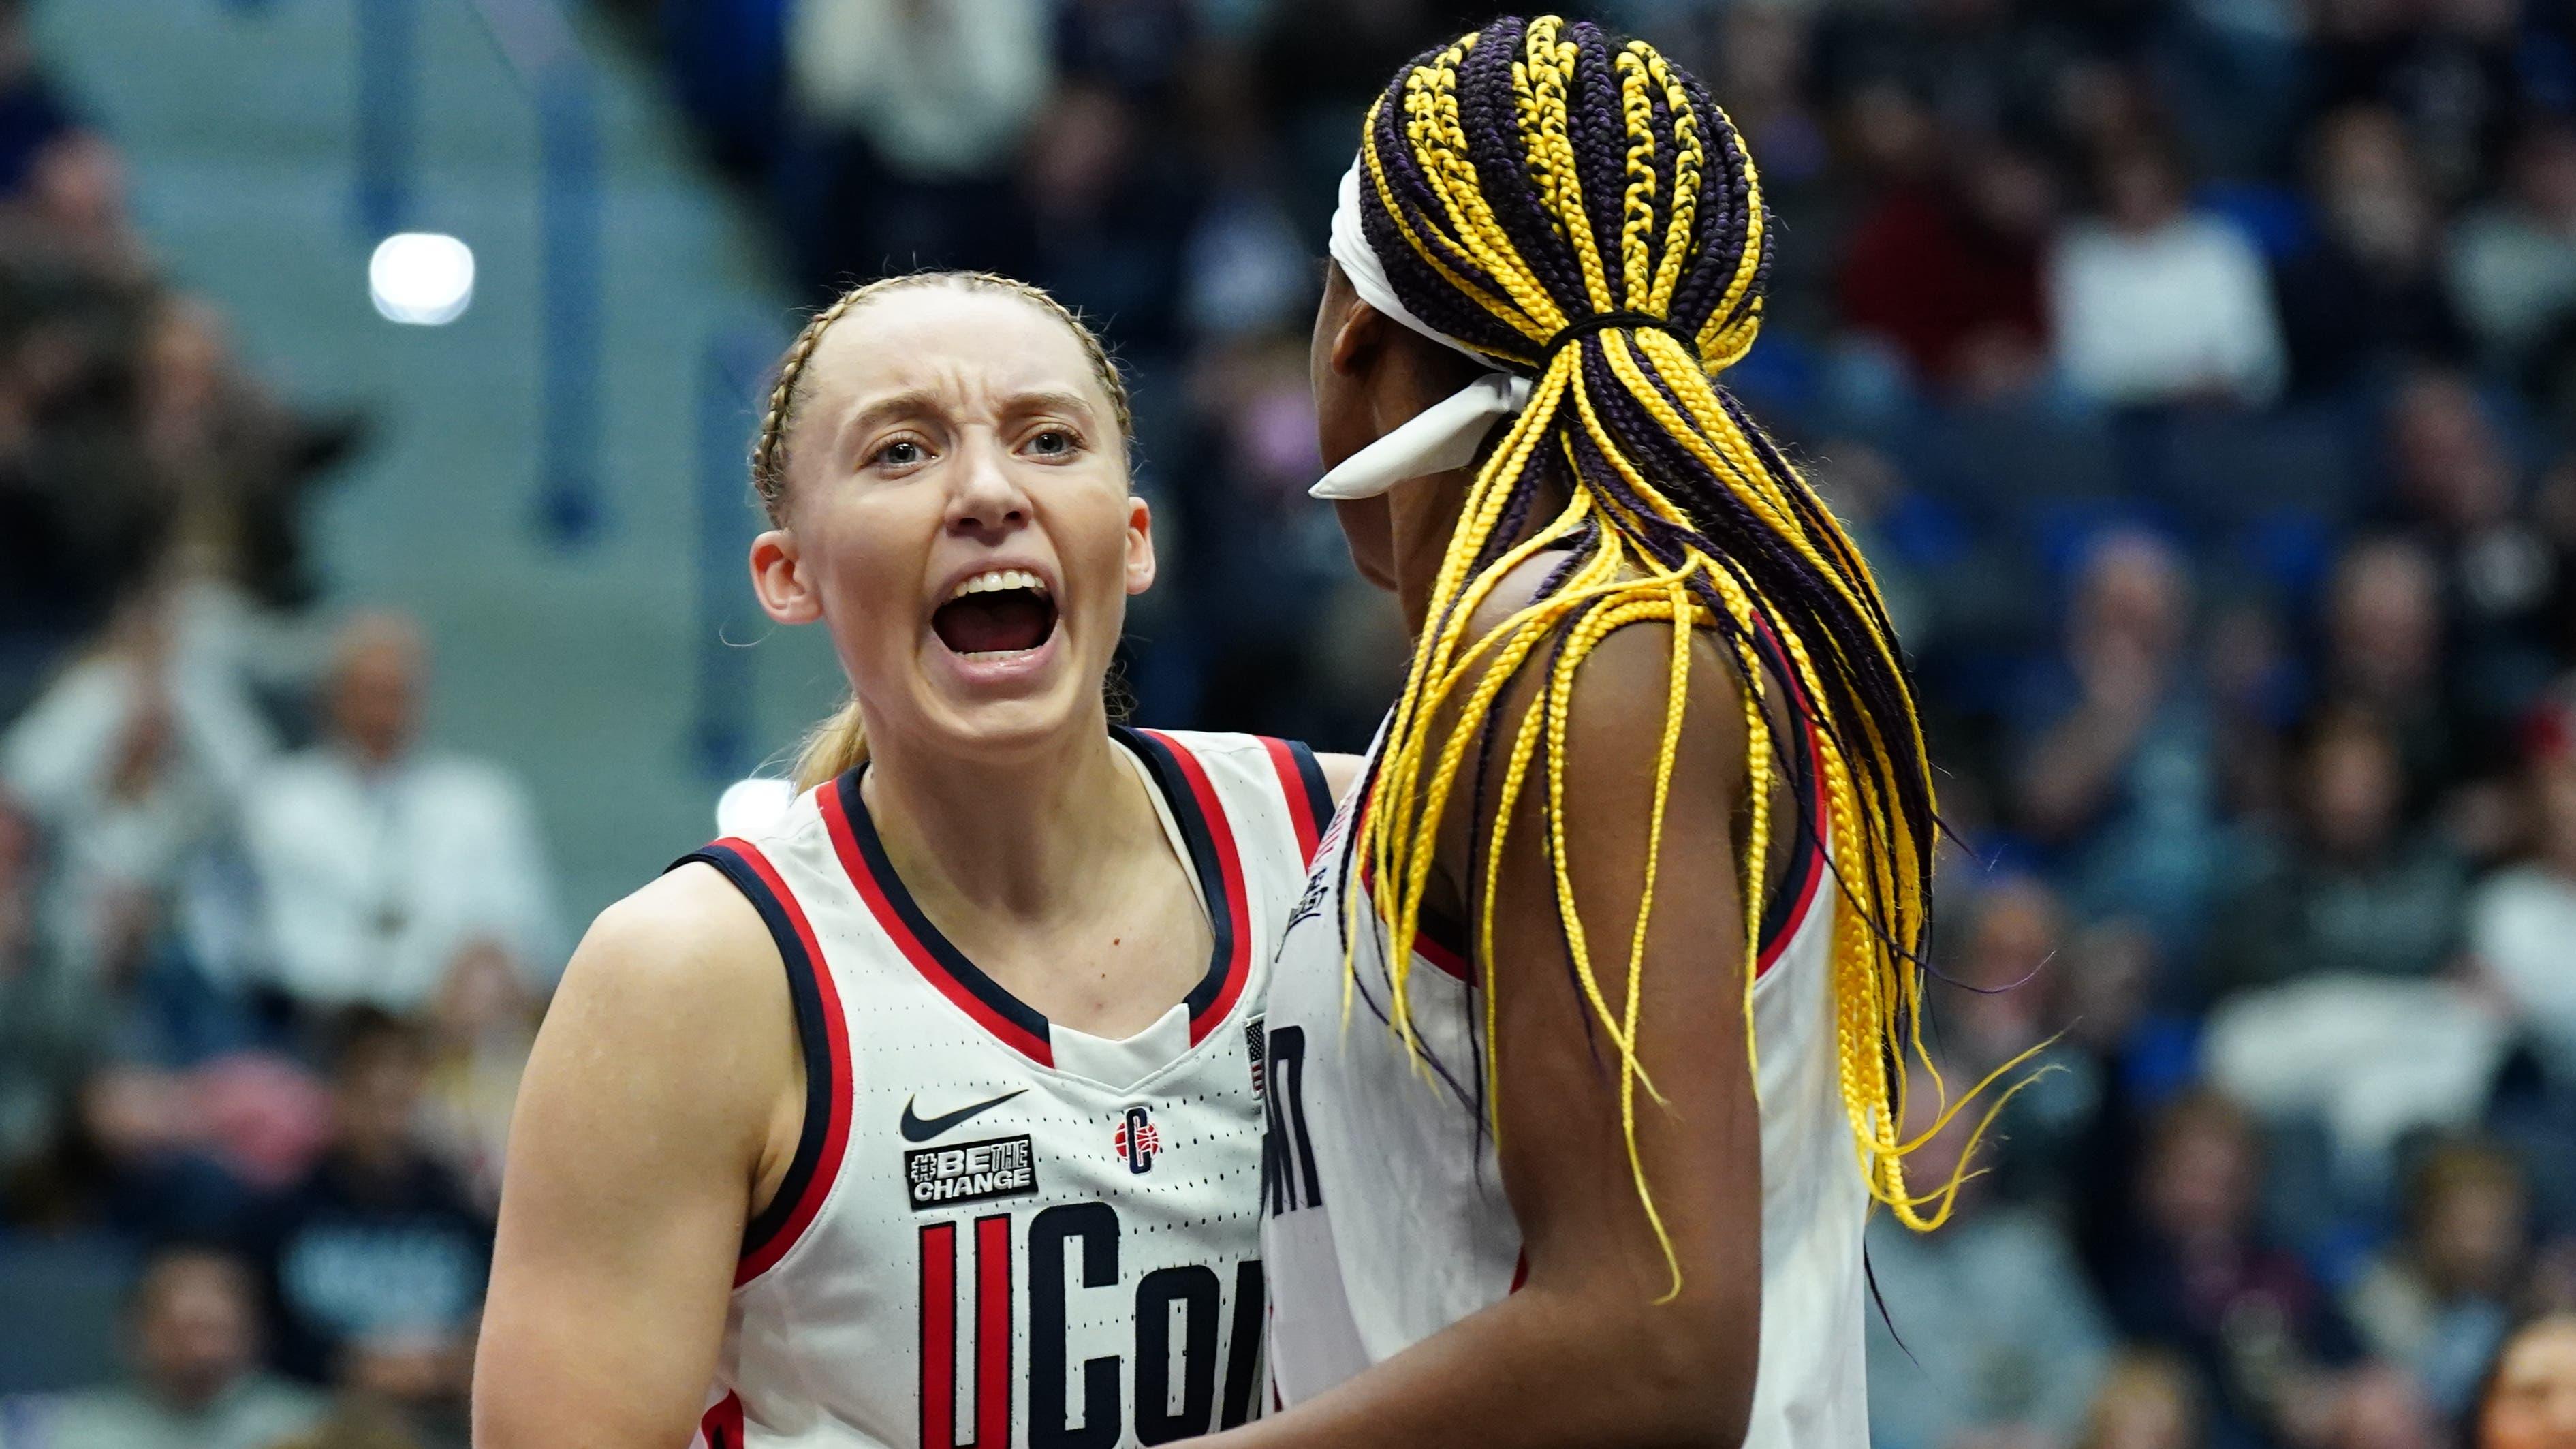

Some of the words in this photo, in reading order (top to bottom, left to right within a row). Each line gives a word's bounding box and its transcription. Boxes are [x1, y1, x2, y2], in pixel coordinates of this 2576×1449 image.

[911, 1146, 990, 1183] #BE
[991, 1140, 1028, 1172] THE
[914, 1168, 1031, 1202] CHANGE
